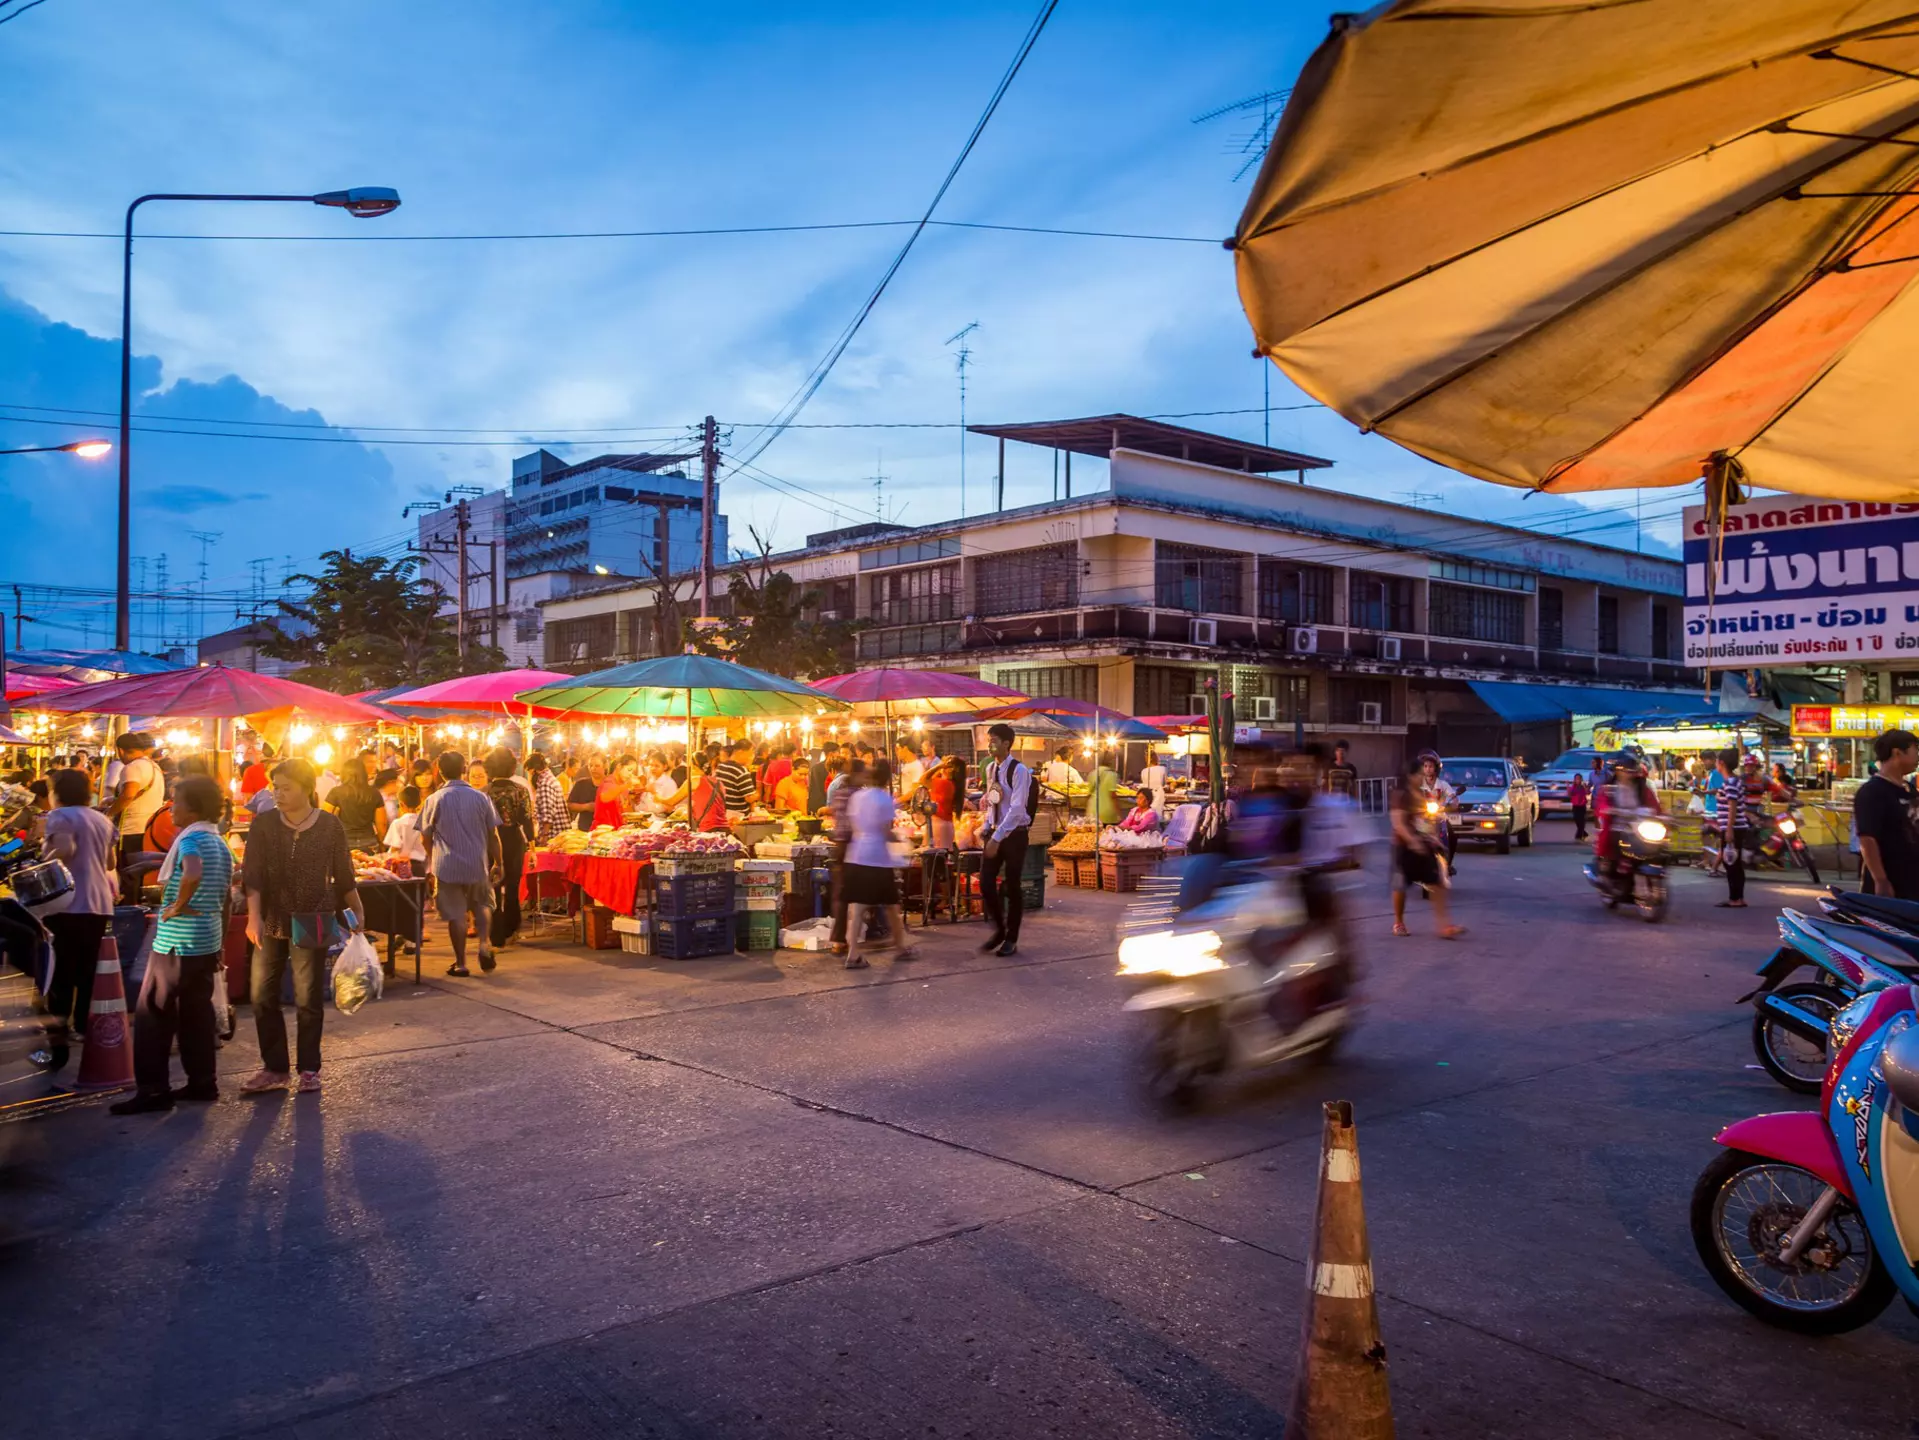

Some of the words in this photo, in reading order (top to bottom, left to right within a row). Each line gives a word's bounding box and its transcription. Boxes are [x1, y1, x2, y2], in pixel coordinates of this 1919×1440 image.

[1784, 636, 1847, 655] รับประกัน
[1856, 637, 1863, 651] 1
